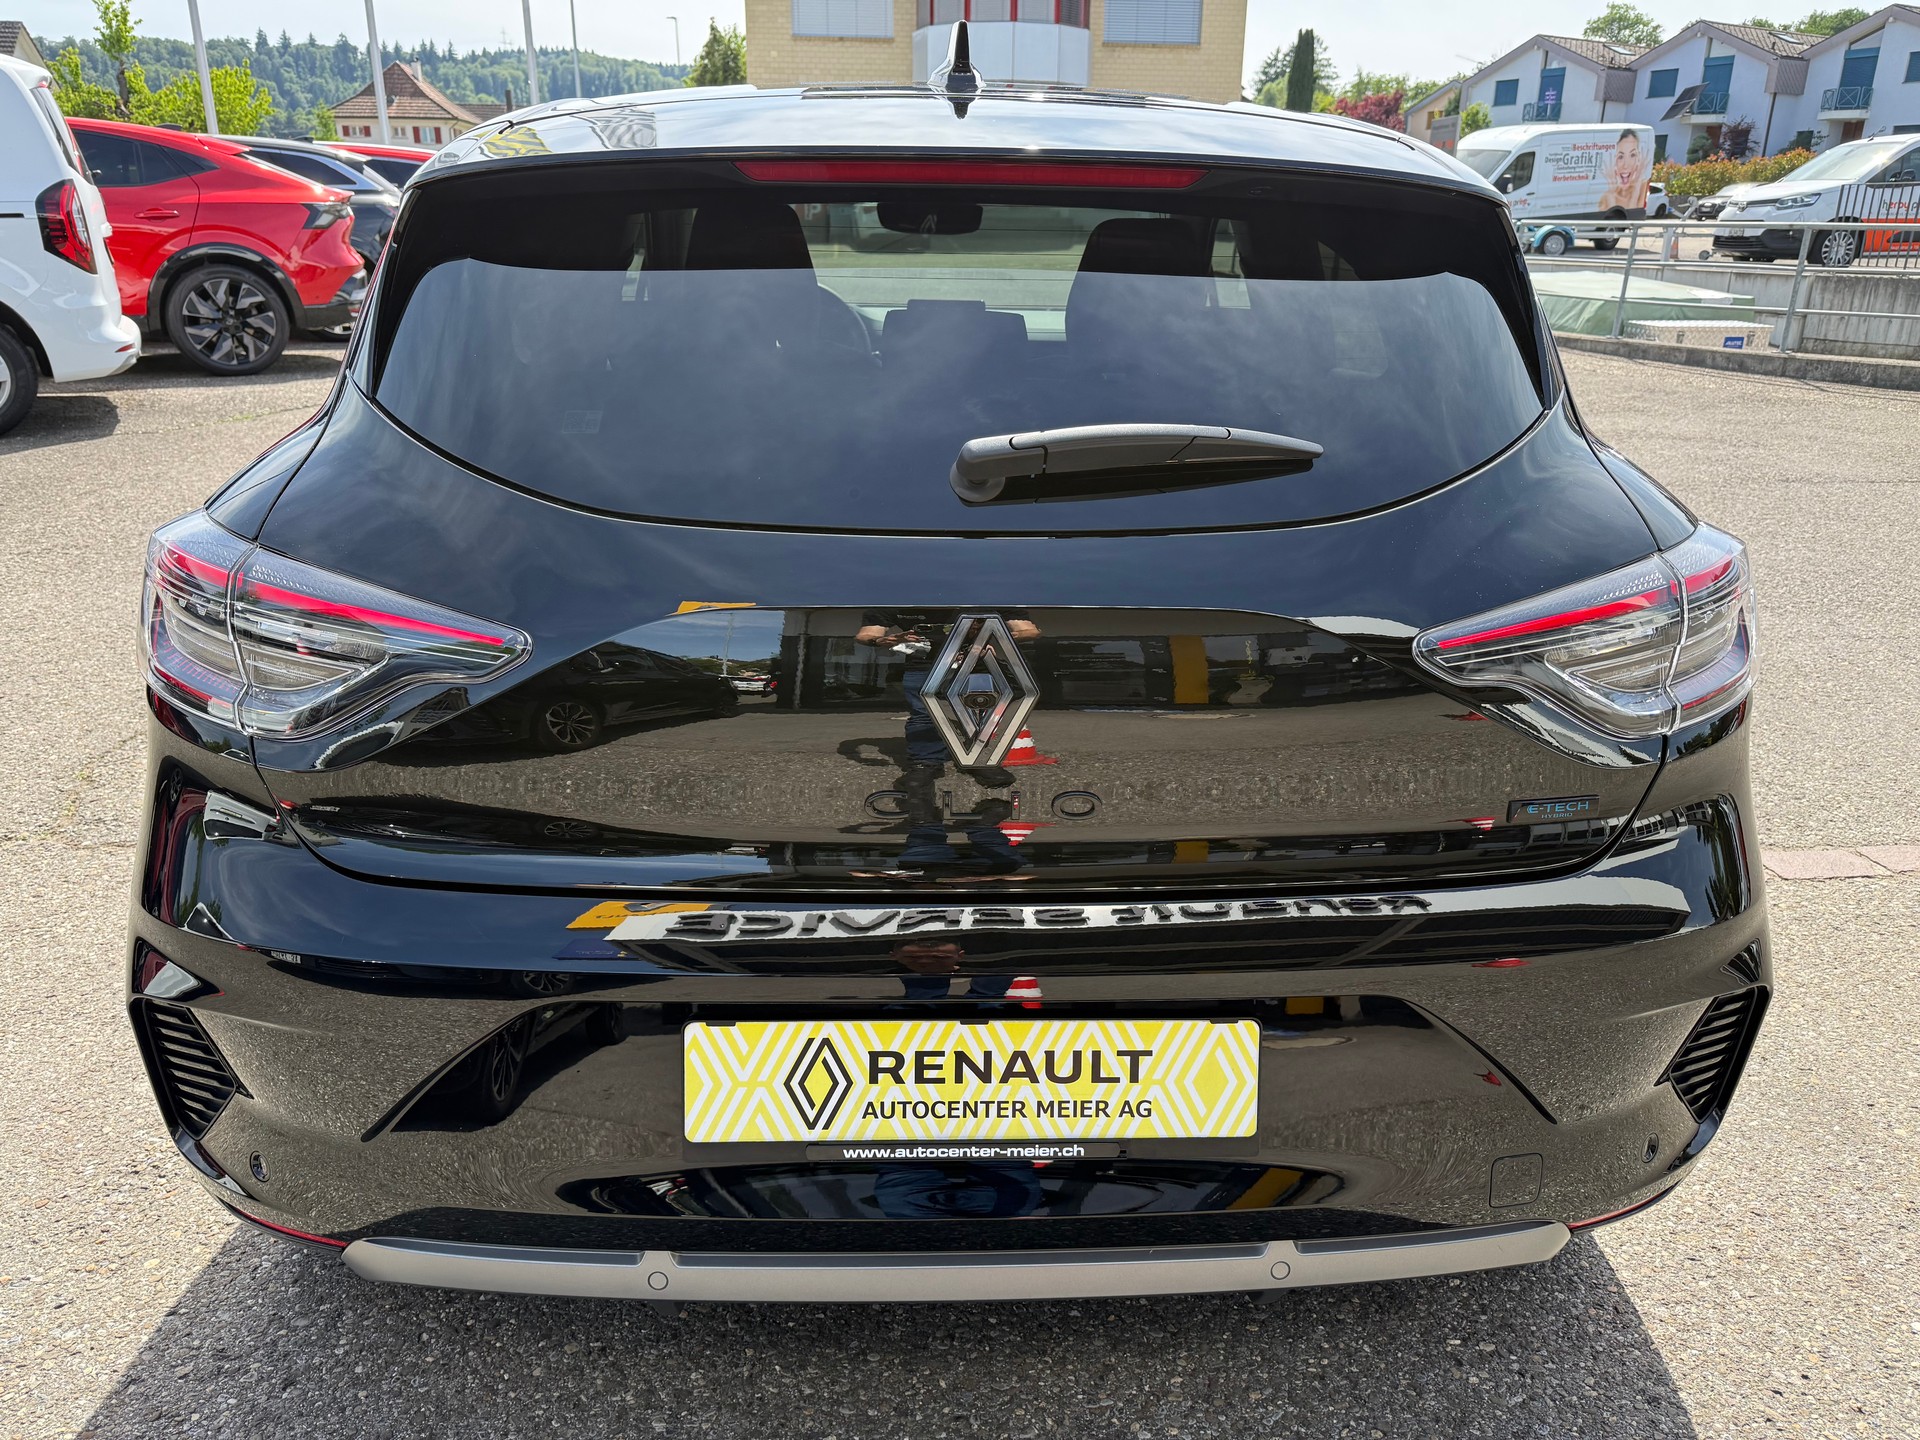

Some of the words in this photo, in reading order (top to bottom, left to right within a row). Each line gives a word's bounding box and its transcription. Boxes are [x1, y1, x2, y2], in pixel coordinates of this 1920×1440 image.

[1573, 143, 1615, 152] Beschriftungen
[1545, 157, 1563, 165] Design
[1563, 152, 1593, 165] Grafik
[1552, 174, 1589, 182] Werbetechnik
[864, 789, 1103, 821] CLIO
[1527, 801, 1589, 814] E-TECH
[867, 1050, 1154, 1085] RENAULT
[862, 1100, 1026, 1119] AUTOCENTER
[1036, 1100, 1109, 1119] MEIER
[1119, 1100, 1153, 1119] AG
[843, 1144, 1085, 1160] www.autocenter-meier.ch
